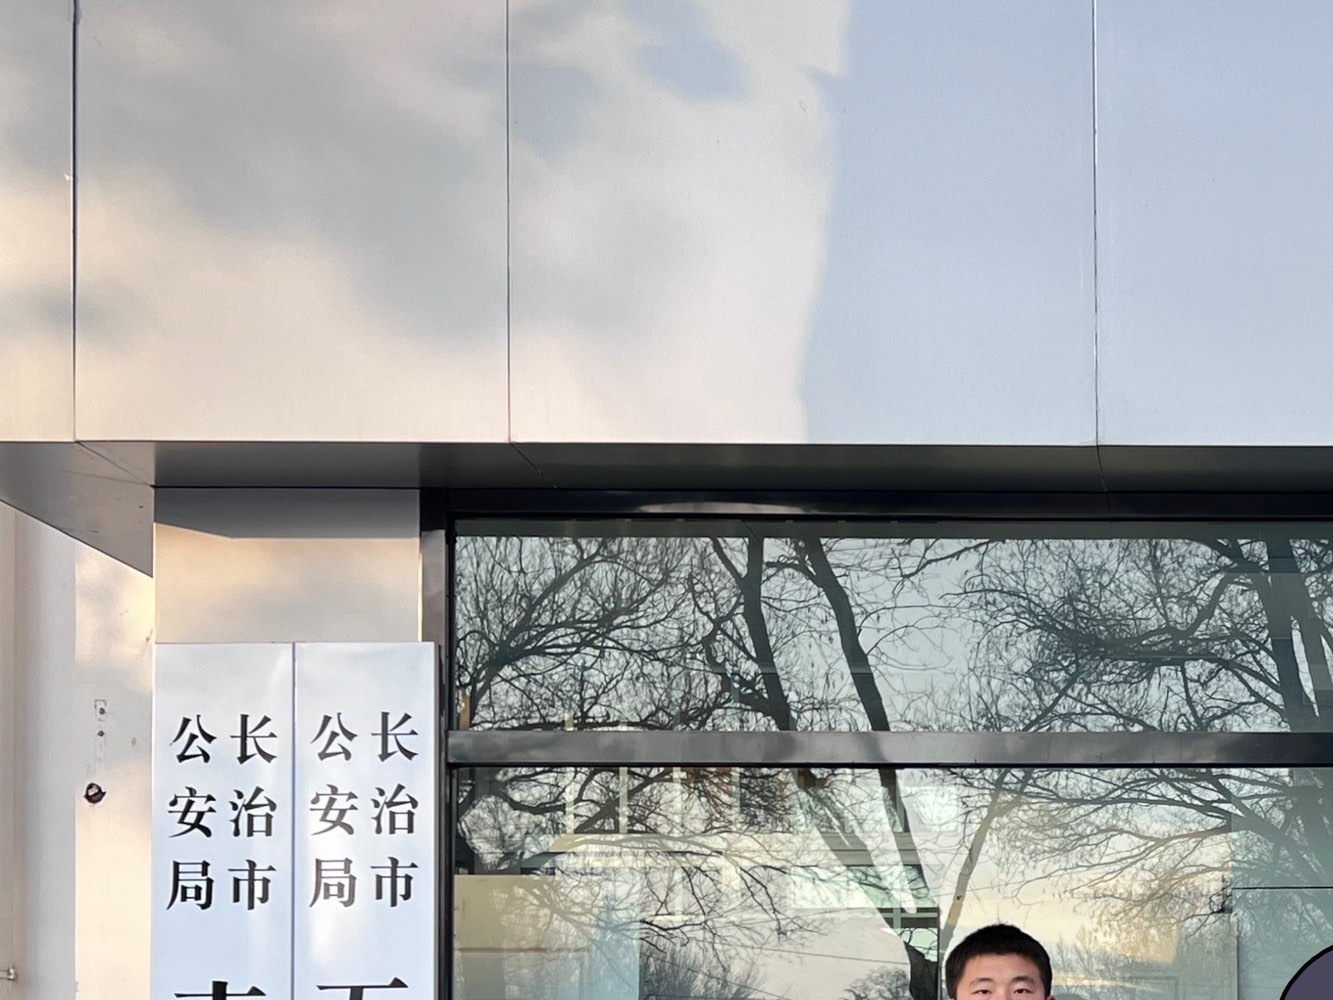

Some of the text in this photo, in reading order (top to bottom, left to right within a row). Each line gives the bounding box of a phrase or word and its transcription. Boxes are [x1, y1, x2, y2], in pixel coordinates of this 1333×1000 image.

[166, 713, 217, 911] 公安局
[228, 713, 277, 911] 长治市
[310, 712, 358, 908] 公安局
[371, 711, 419, 908] 长治市
